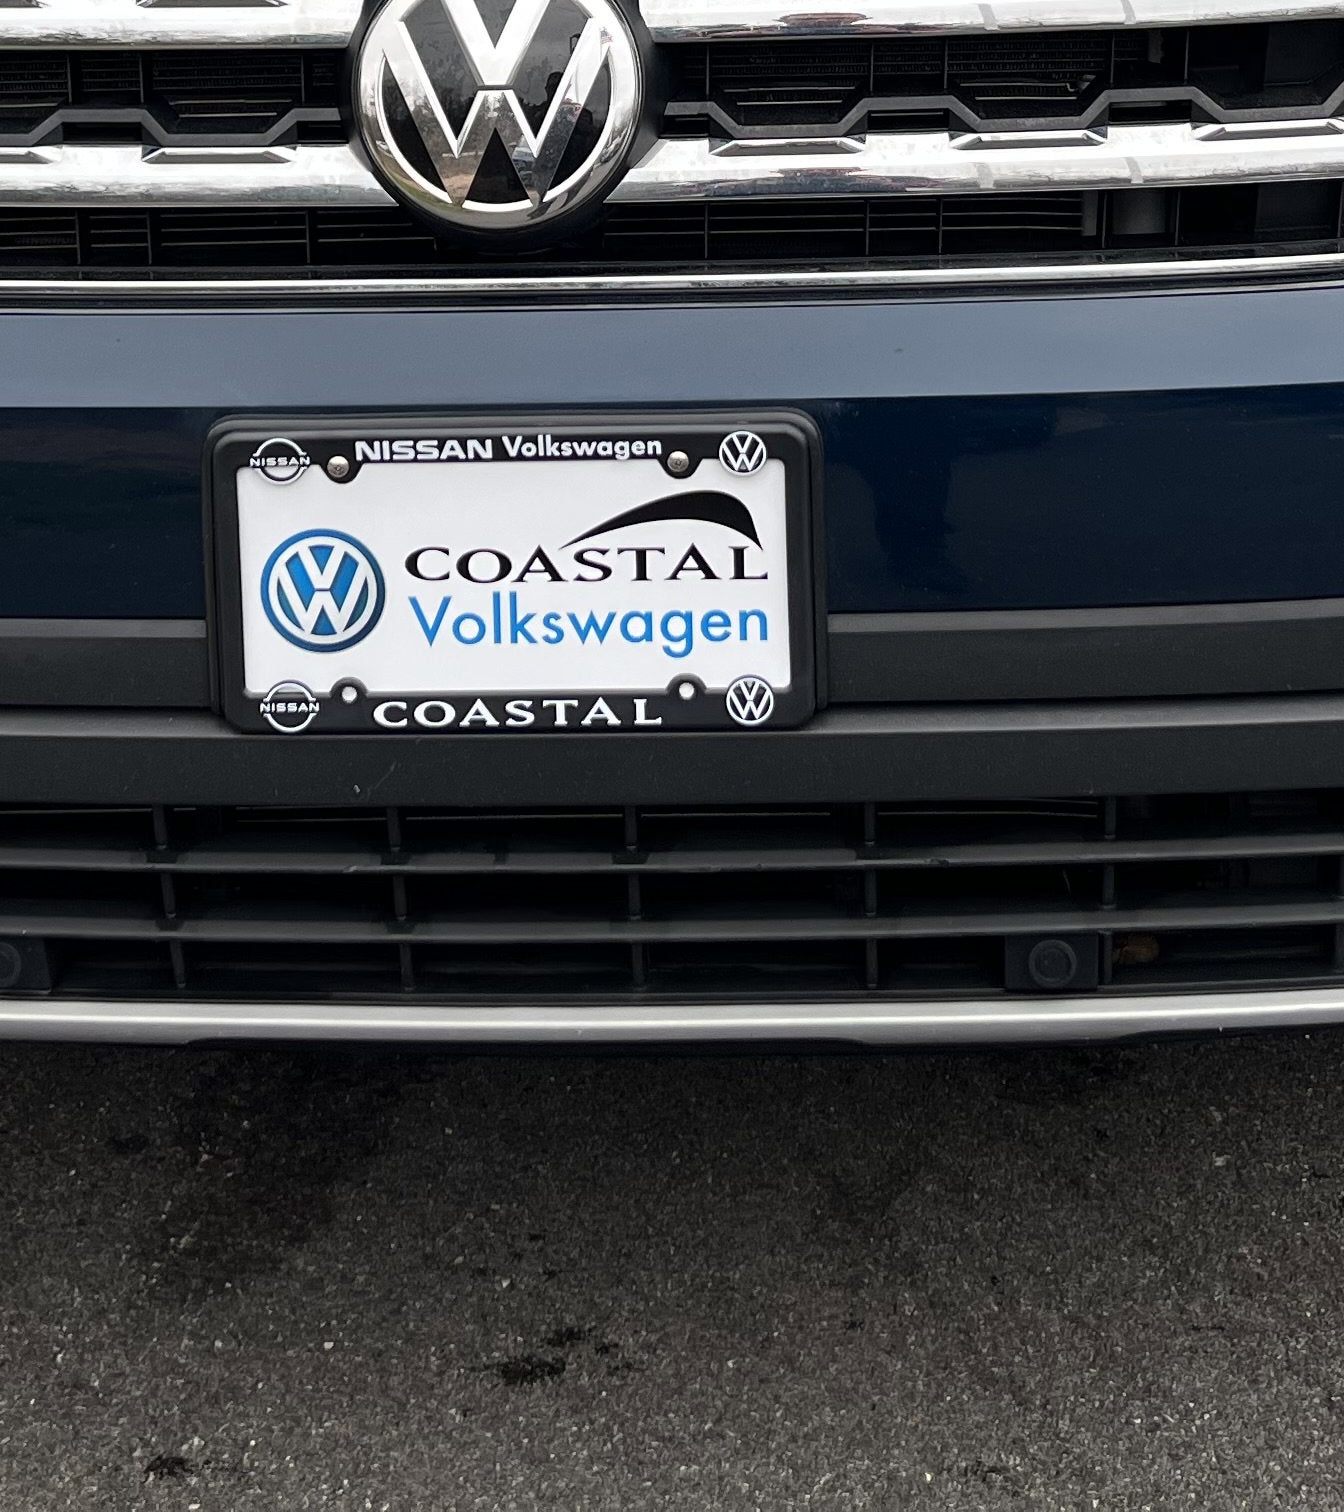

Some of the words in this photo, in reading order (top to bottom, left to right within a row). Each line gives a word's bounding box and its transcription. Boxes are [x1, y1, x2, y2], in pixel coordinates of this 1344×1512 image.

[249, 456, 311, 467] NISSAN
[355, 438, 493, 462] NISSAN
[501, 434, 662, 460] Volkswagen
[404, 544, 769, 584] COASTAL
[407, 591, 768, 658] Volkswagen
[259, 702, 320, 713] NISSAN
[373, 698, 662, 728] COASTAL
